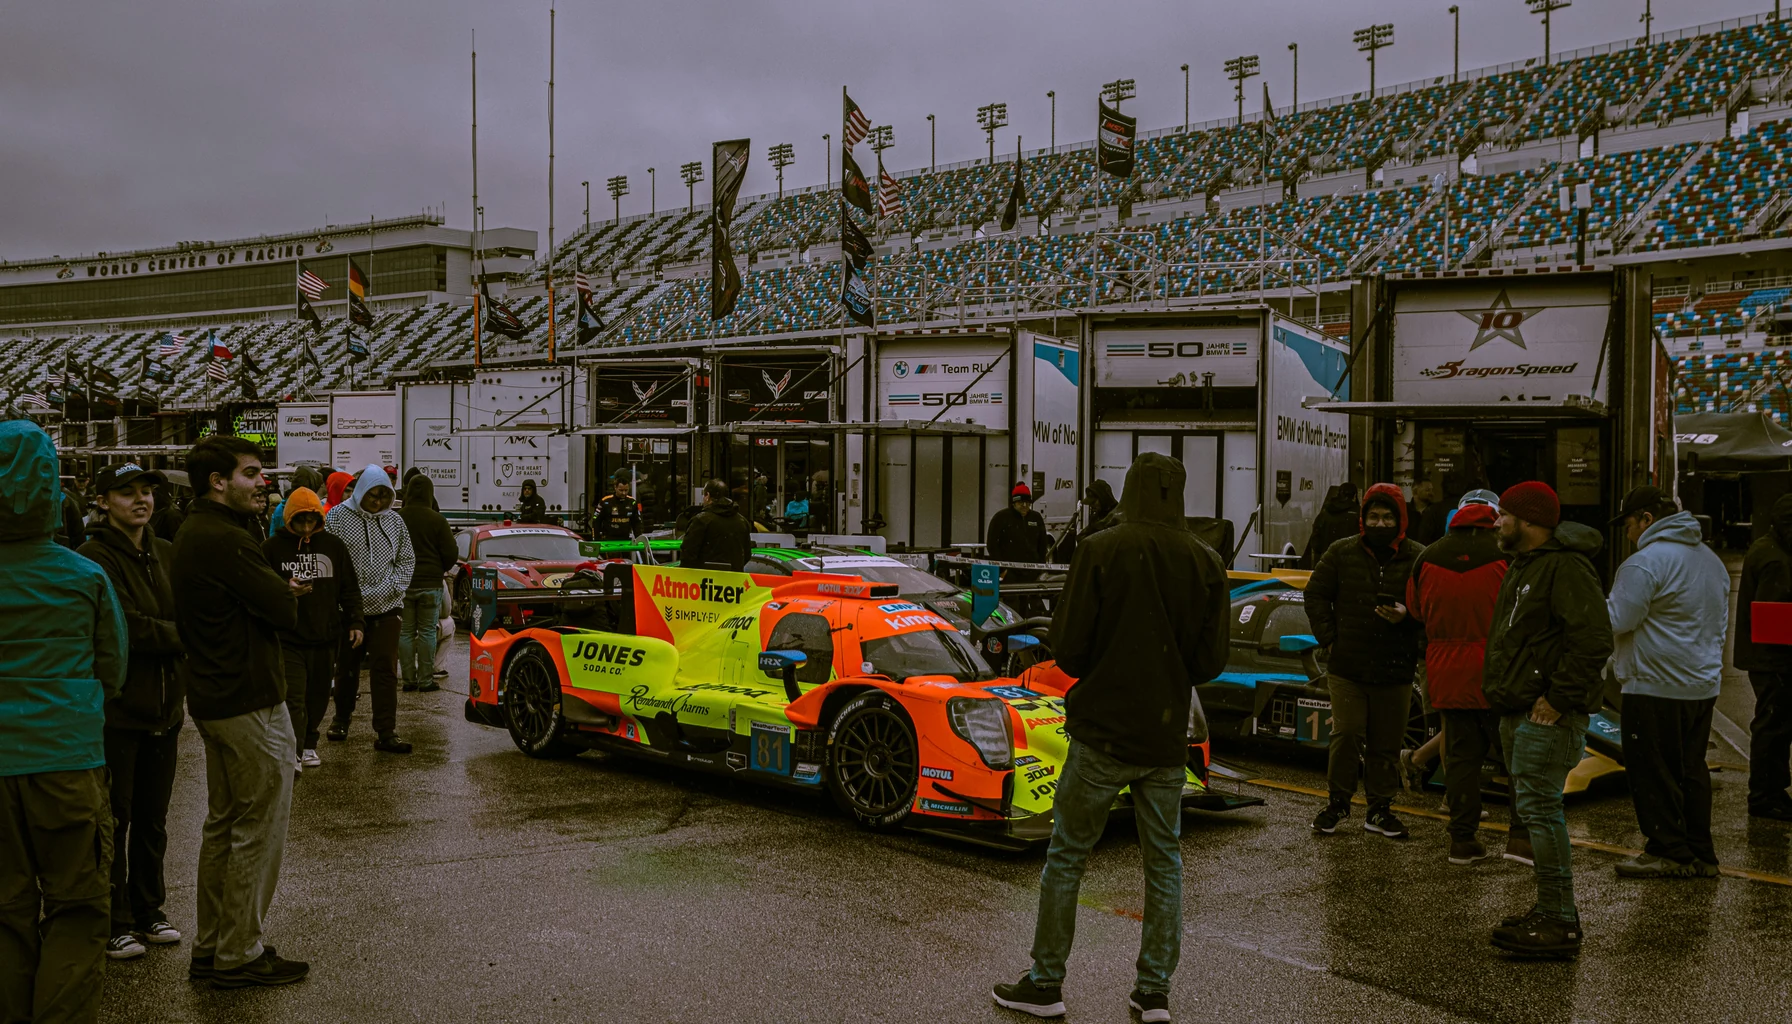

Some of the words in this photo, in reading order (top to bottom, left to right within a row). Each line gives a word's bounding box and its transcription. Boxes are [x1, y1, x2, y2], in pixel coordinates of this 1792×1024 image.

[87, 262, 138, 277] WORLD
[148, 255, 206, 272] CENTER
[217, 251, 236, 265] OF
[245, 244, 304, 262] RACING
[1478, 311, 1525, 331] 10
[1148, 342, 1203, 358] 50
[941, 364, 969, 374] Team
[922, 392, 967, 406] 50
[1052, 423, 1062, 444] of
[1278, 415, 1297, 442] BMW
[1297, 420, 1305, 443] of
[1305, 420, 1323, 447] North
[1323, 424, 1347, 450] America
[422, 438, 453, 450] AMR
[504, 436, 538, 448] AMR
[296, 553, 316, 562] THE
[281, 561, 317, 571] NORTH
[292, 570, 317, 578] FACE
[652, 574, 744, 604] Atmofizer
[817, 583, 841, 594] MOTUL
[572, 640, 646, 666] JONES
[760, 656, 782, 666] HRX
[582, 663, 607, 673] SODA
[625, 684, 672, 711] Rembrandt
[672, 693, 710, 715] Charms
[1299, 700, 1332, 708] Weather
[833, 699, 865, 730] MICHELIN
[752, 722, 789, 732] WeatherTech
[757, 733, 783, 771] 81
[921, 767, 952, 779] MOTUL
[931, 802, 969, 812] MICHELIN
